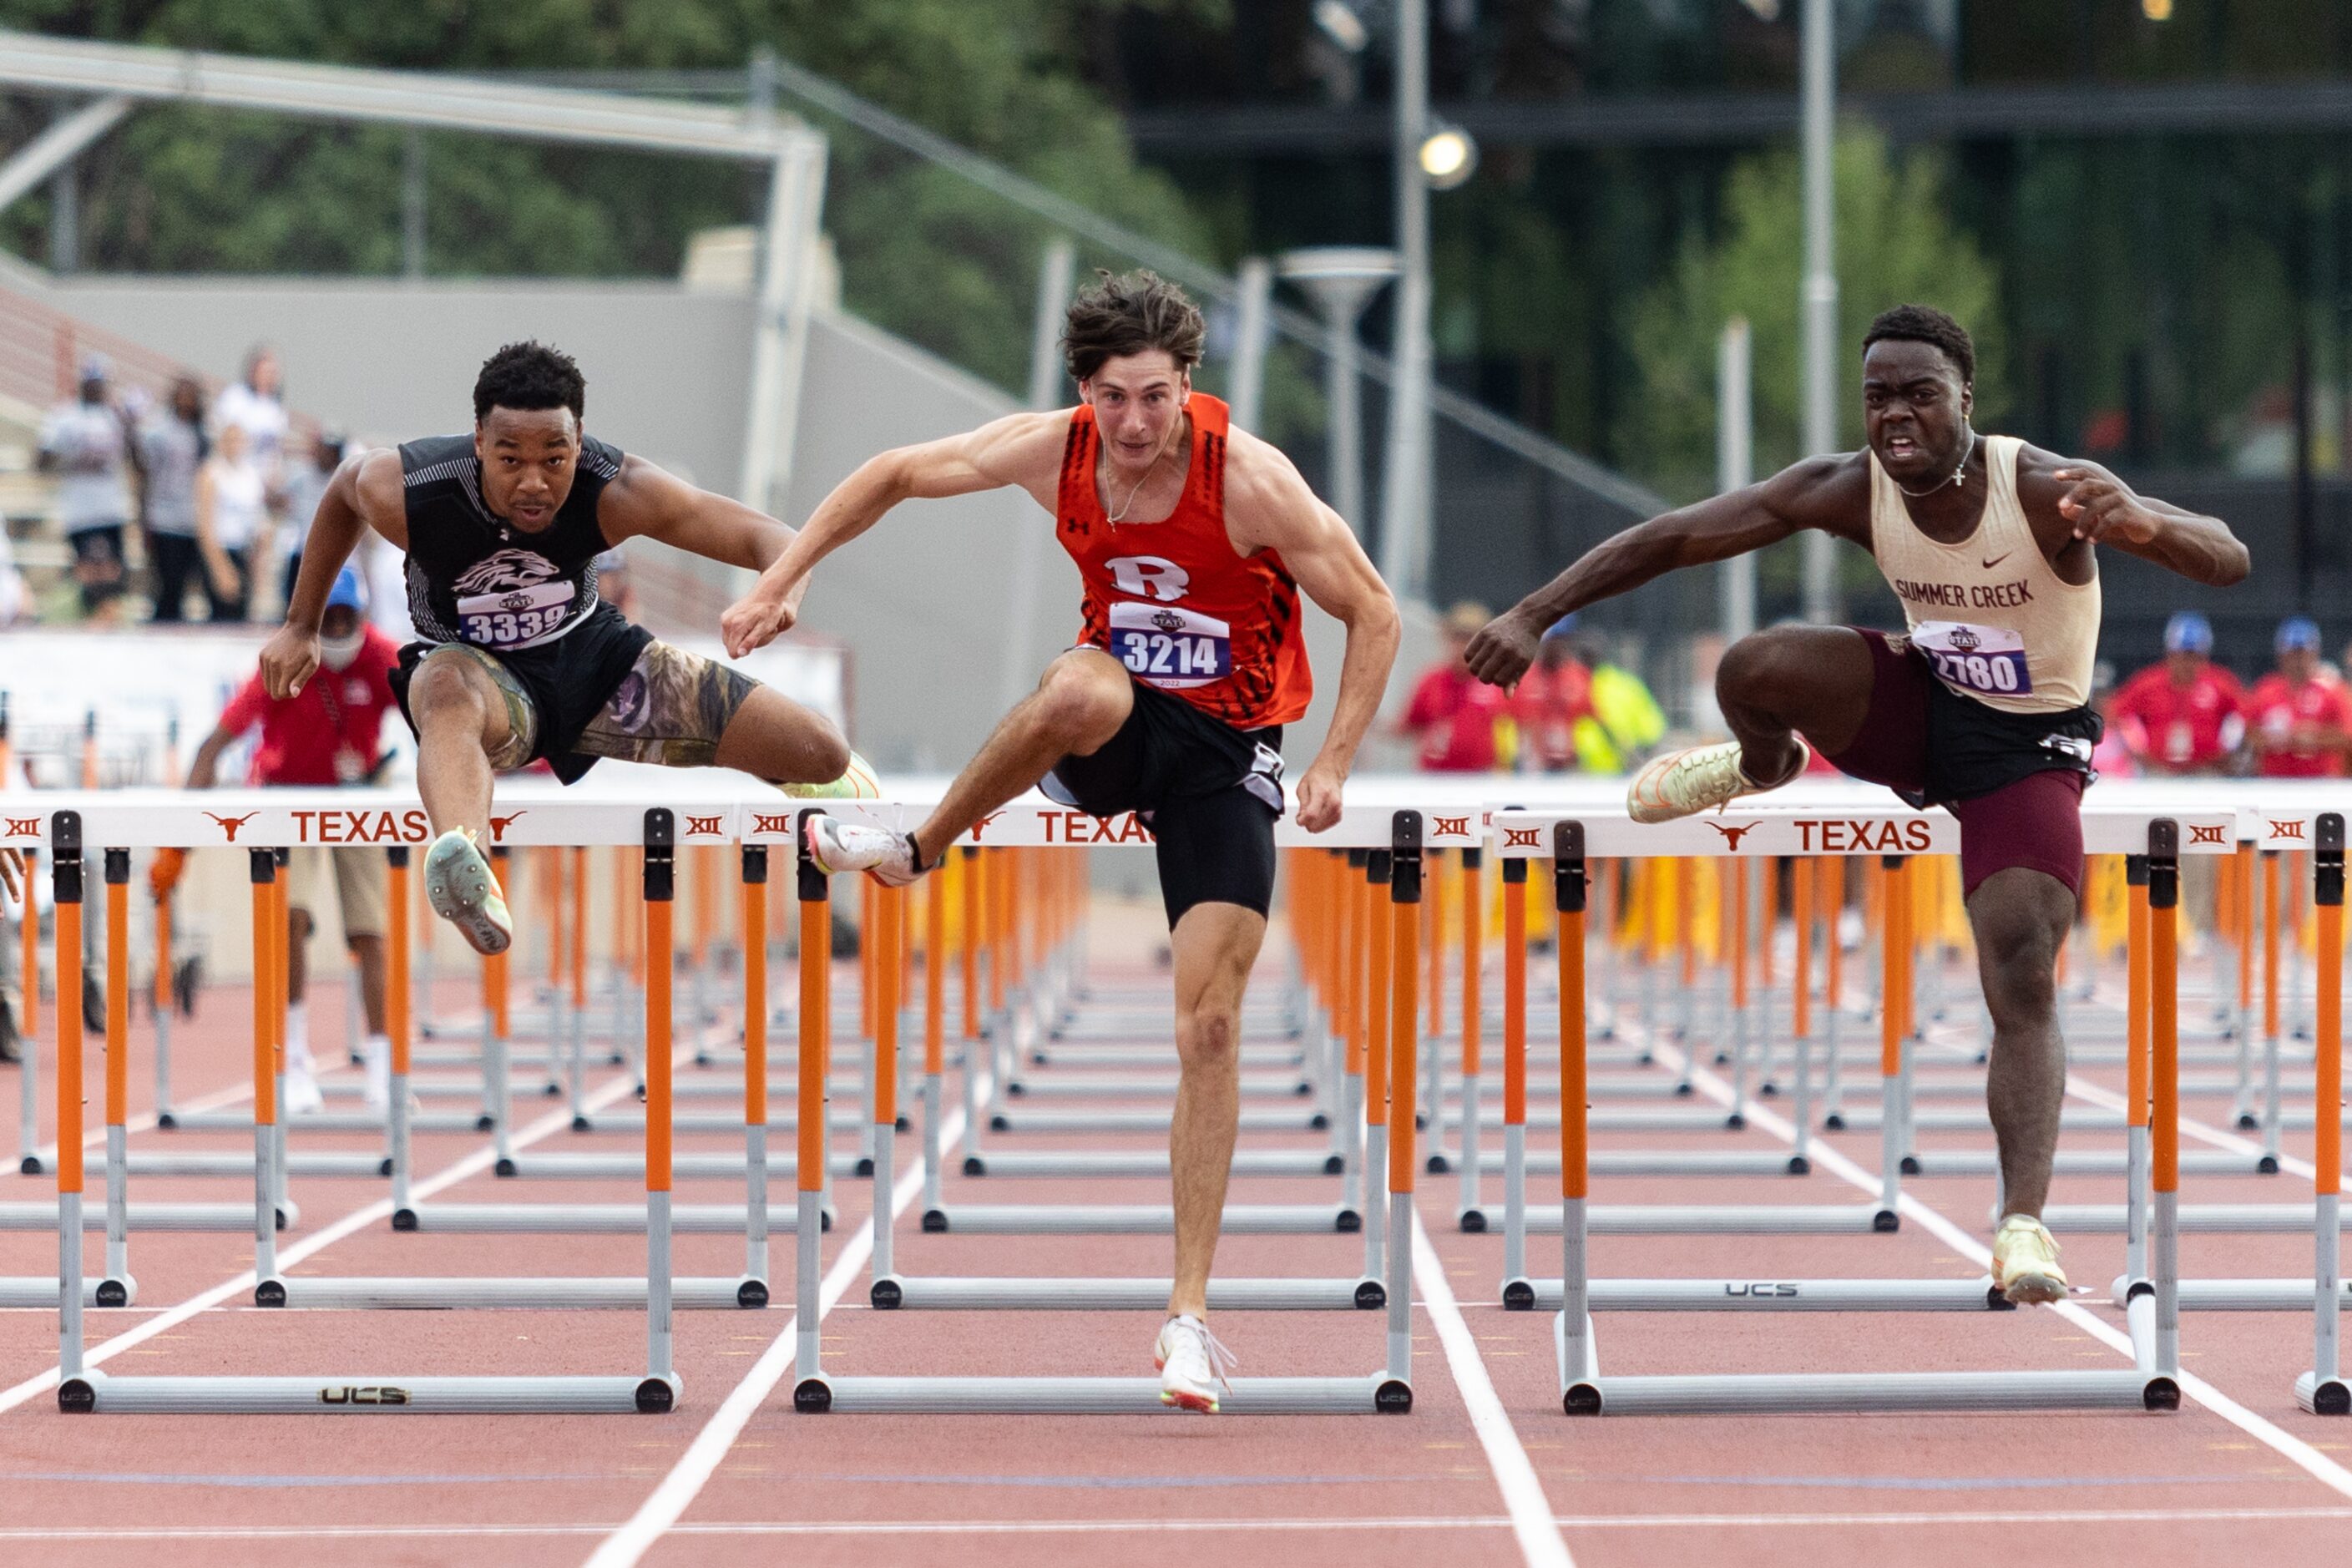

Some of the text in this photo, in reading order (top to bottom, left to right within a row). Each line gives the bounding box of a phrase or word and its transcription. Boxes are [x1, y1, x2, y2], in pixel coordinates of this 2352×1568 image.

[1104, 555, 1190, 602] R
[1895, 579, 2034, 608] SUMMER CREEK
[468, 604, 566, 644] 3339
[1124, 632, 1218, 675] 3214
[1931, 650, 2019, 691] 2780
[291, 810, 428, 843] TEXAS
[1036, 811, 1157, 843] TEXA
[1793, 819, 1931, 852] TEXAS
[1725, 1282, 1798, 1297] UCS
[321, 1387, 407, 1404] UCS
